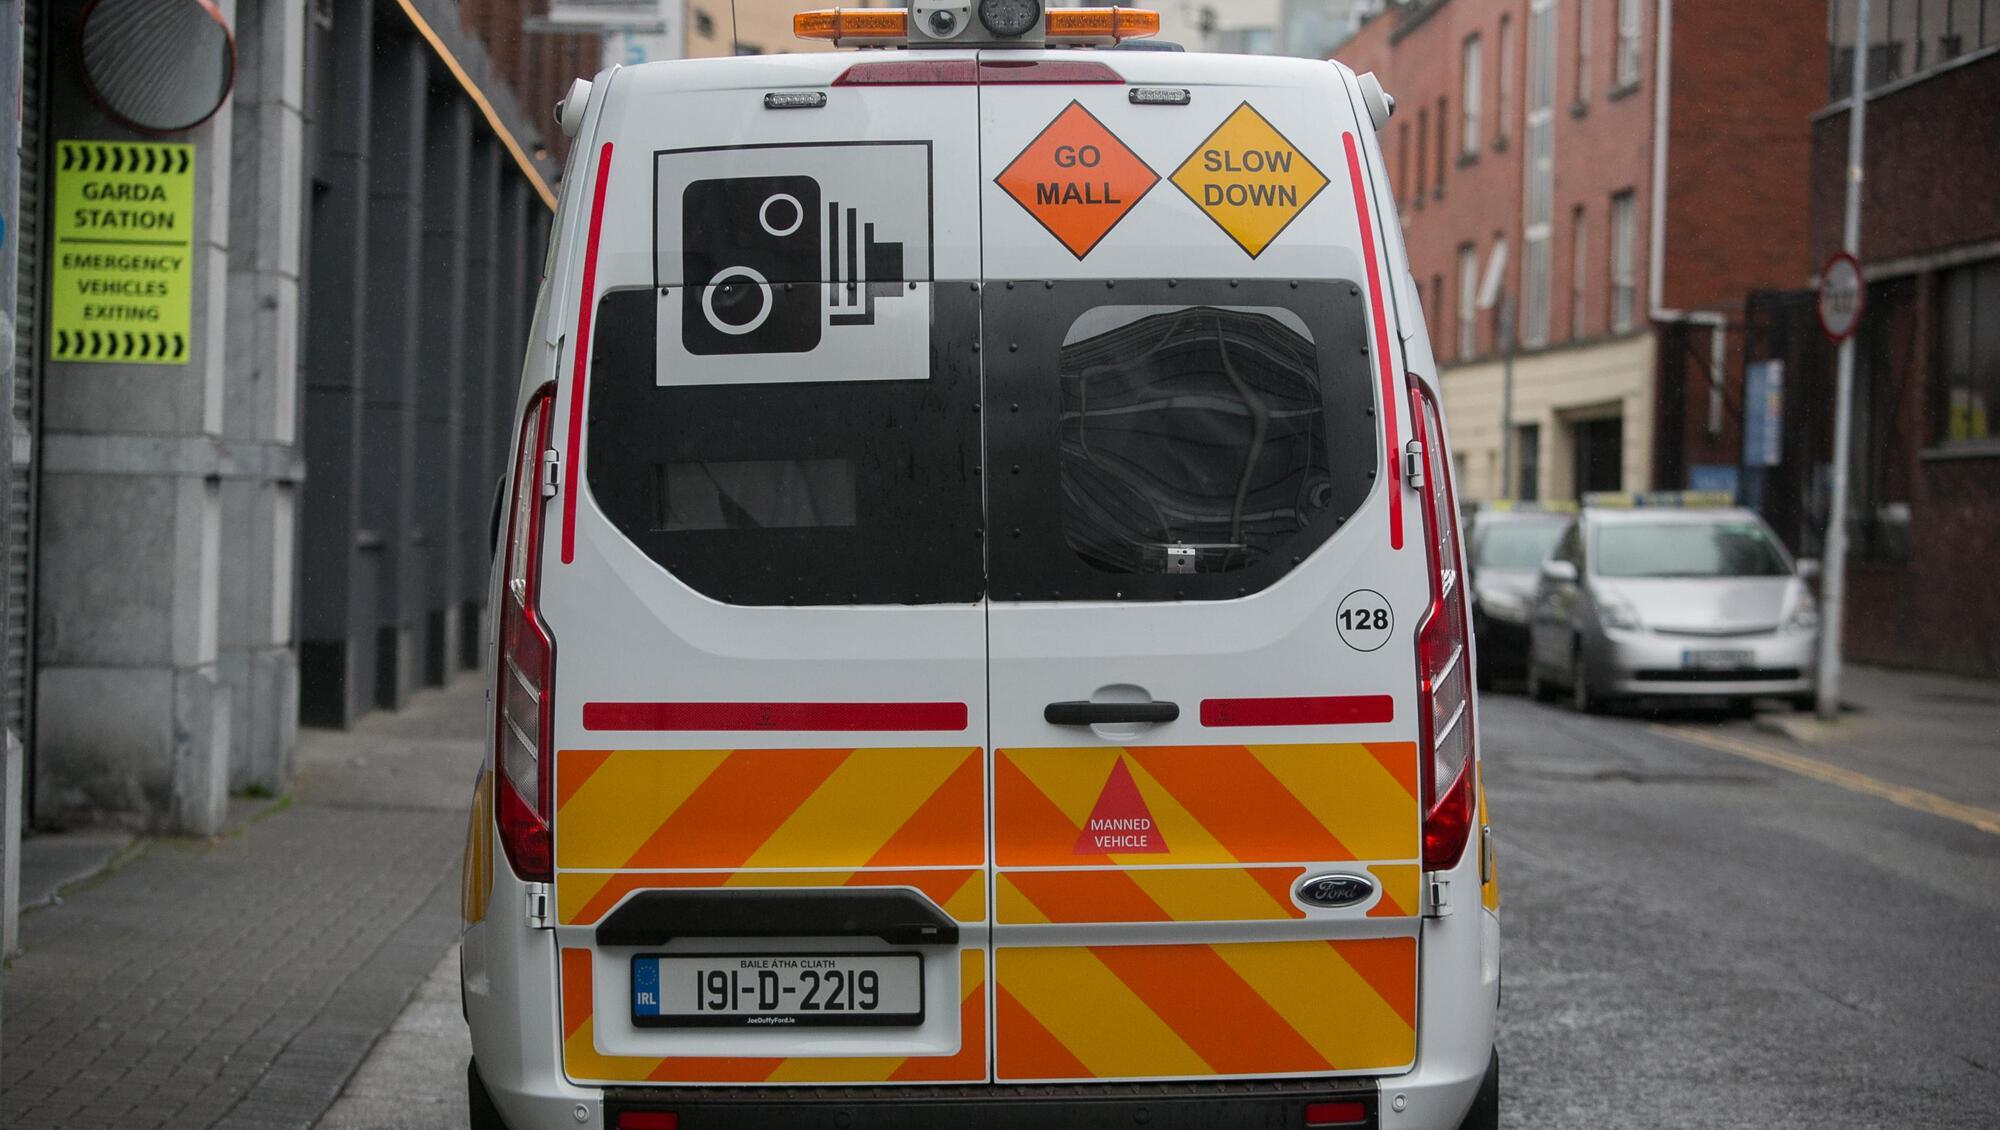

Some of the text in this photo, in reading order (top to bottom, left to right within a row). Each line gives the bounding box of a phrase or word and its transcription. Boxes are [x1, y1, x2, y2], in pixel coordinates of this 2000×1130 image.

[1054, 145, 1101, 168] GO
[1204, 150, 1293, 173] SLOW
[82, 181, 167, 202] GARDA
[1036, 181, 1121, 205] MALL
[1204, 183, 1298, 207] DOWN
[74, 208, 175, 230] STATION
[61, 252, 183, 273] EMERGENCY
[77, 278, 169, 298] VEHICLES
[83, 303, 160, 323] EXITING
[1339, 608, 1389, 630] 128
[1090, 818, 1151, 831] MANNED
[1094, 835, 1148, 848] VEHICLE
[1315, 881, 1357, 900] Ford
[740, 958, 836, 969] BAILE ÁTHA CLIATH
[637, 992, 657, 1005] IRL
[697, 970, 879, 1011] 191-D-2219
